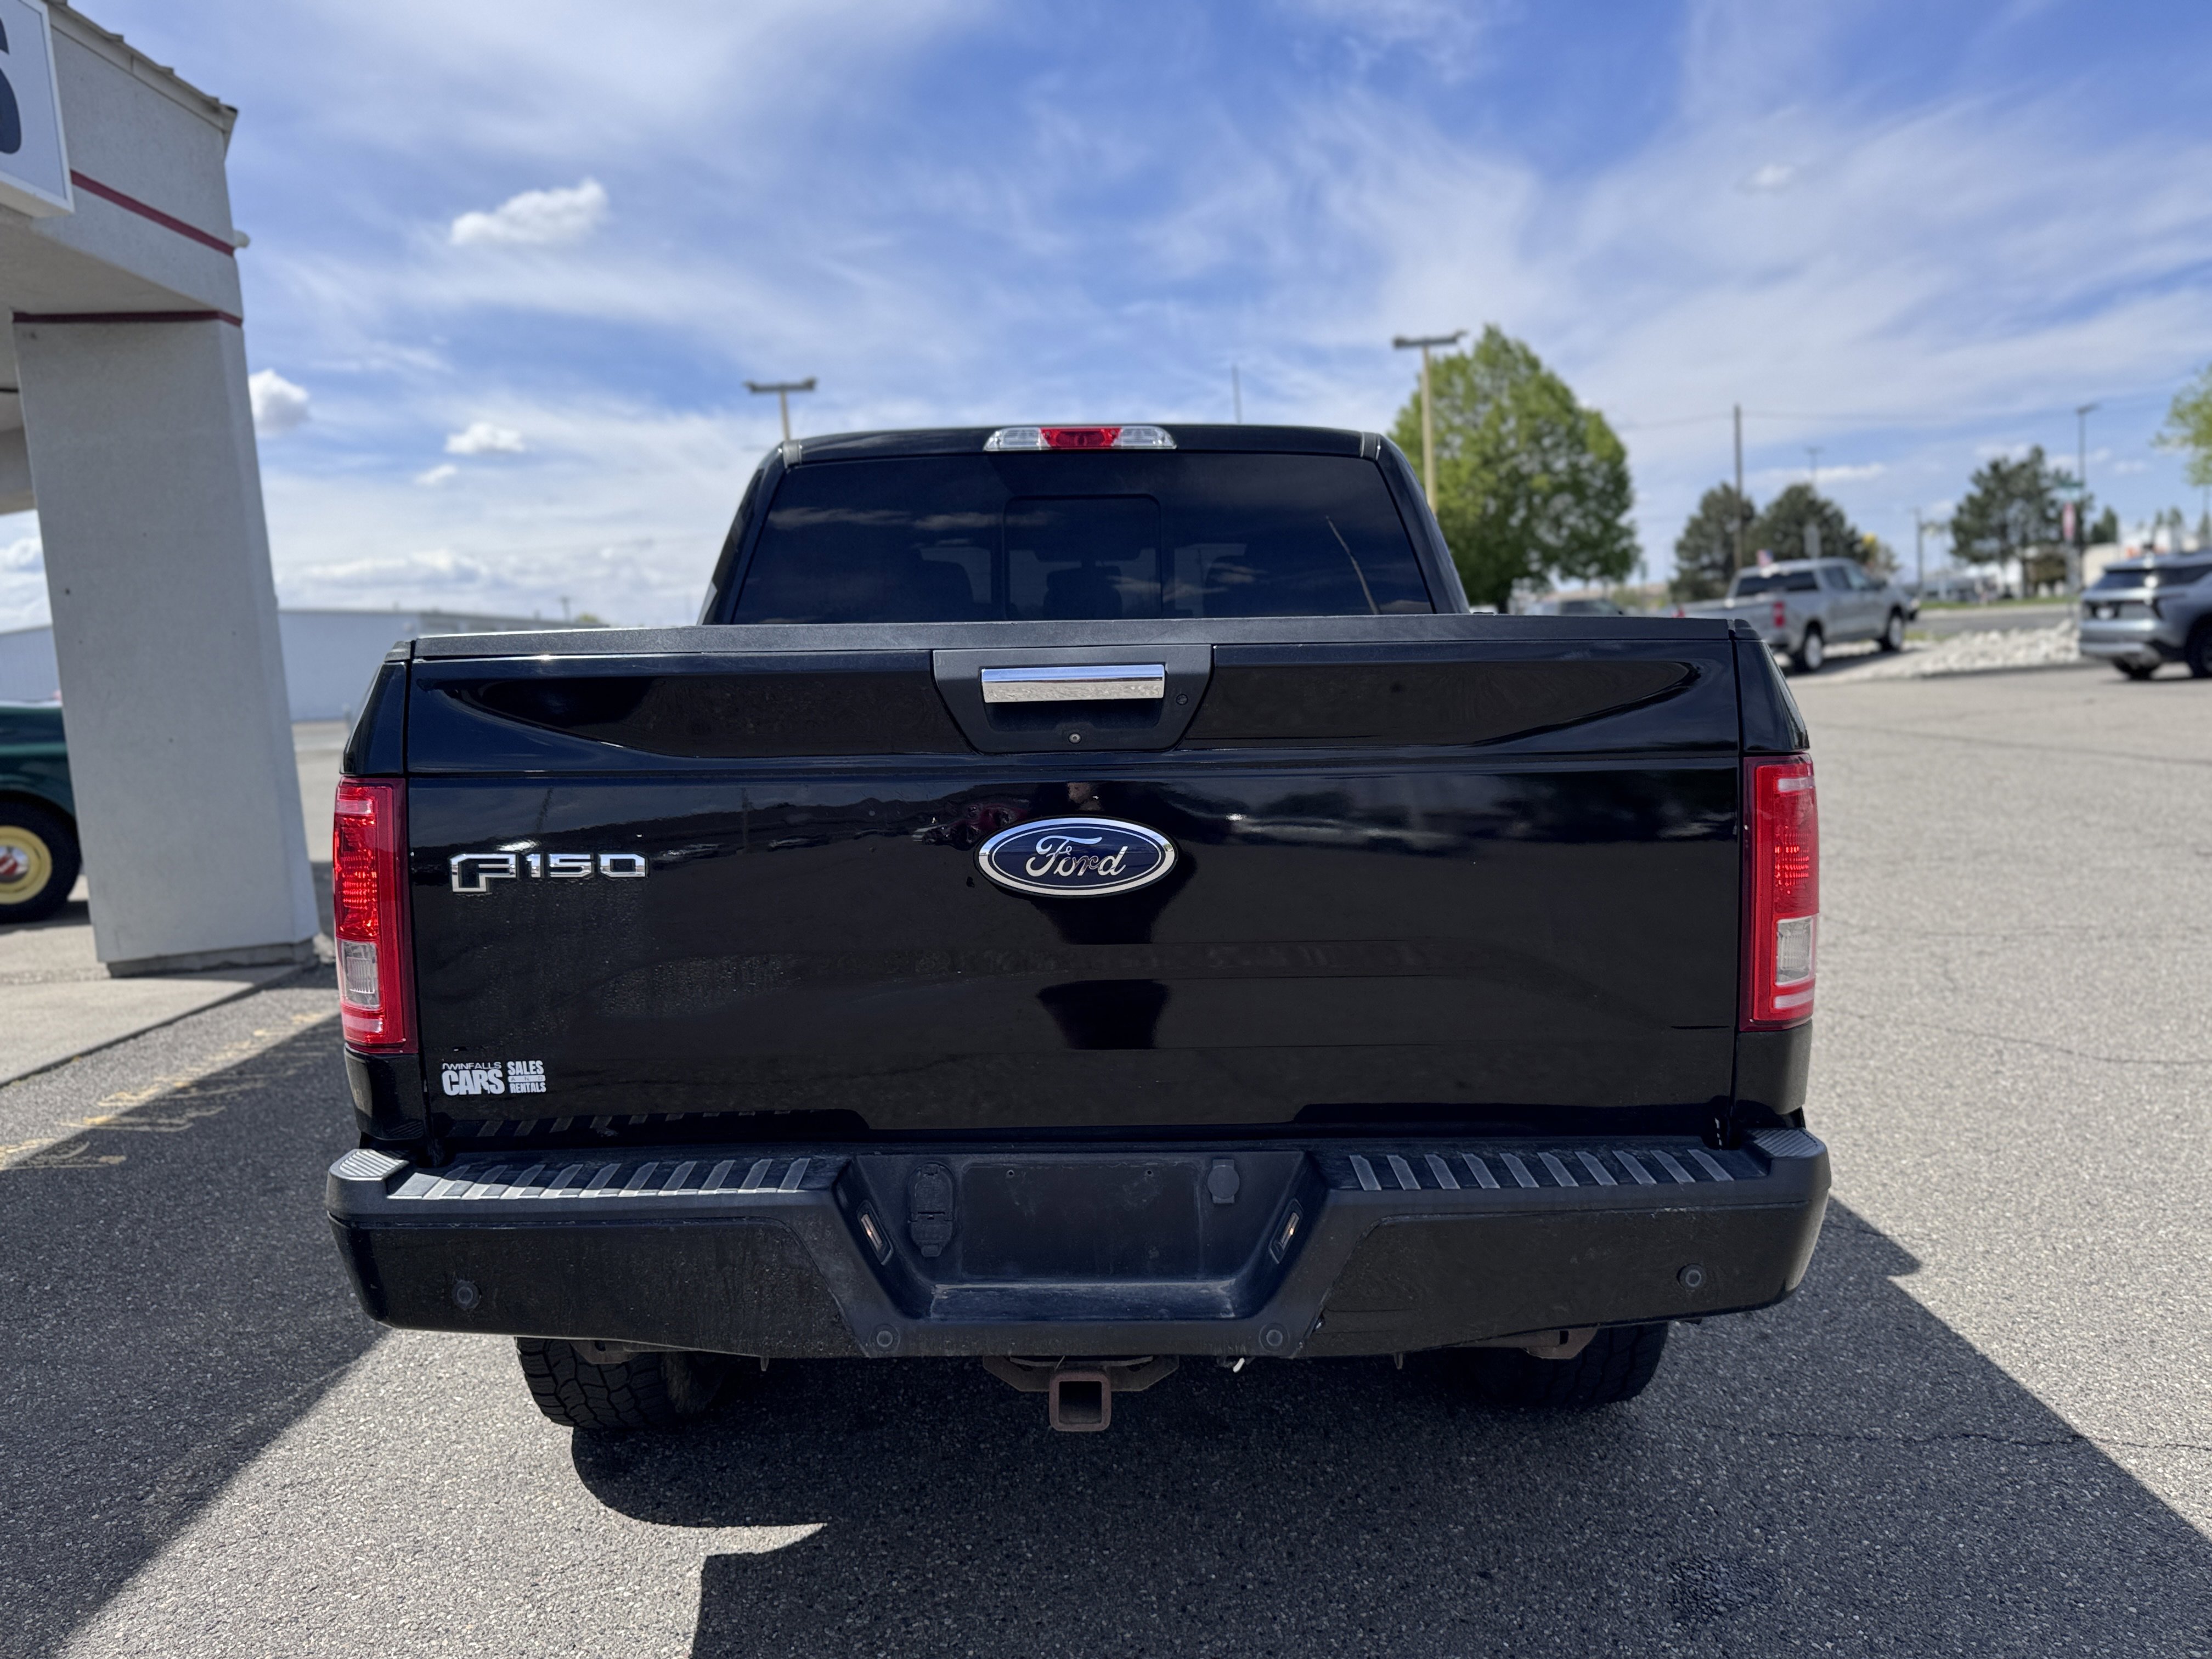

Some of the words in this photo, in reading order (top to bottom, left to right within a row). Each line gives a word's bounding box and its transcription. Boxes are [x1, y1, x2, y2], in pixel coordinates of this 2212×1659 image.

[1026, 835, 1128, 877] Ford
[507, 1060, 544, 1076] SALES
[442, 1069, 505, 1096] CARS
[510, 1082, 546, 1093] RENTALS
